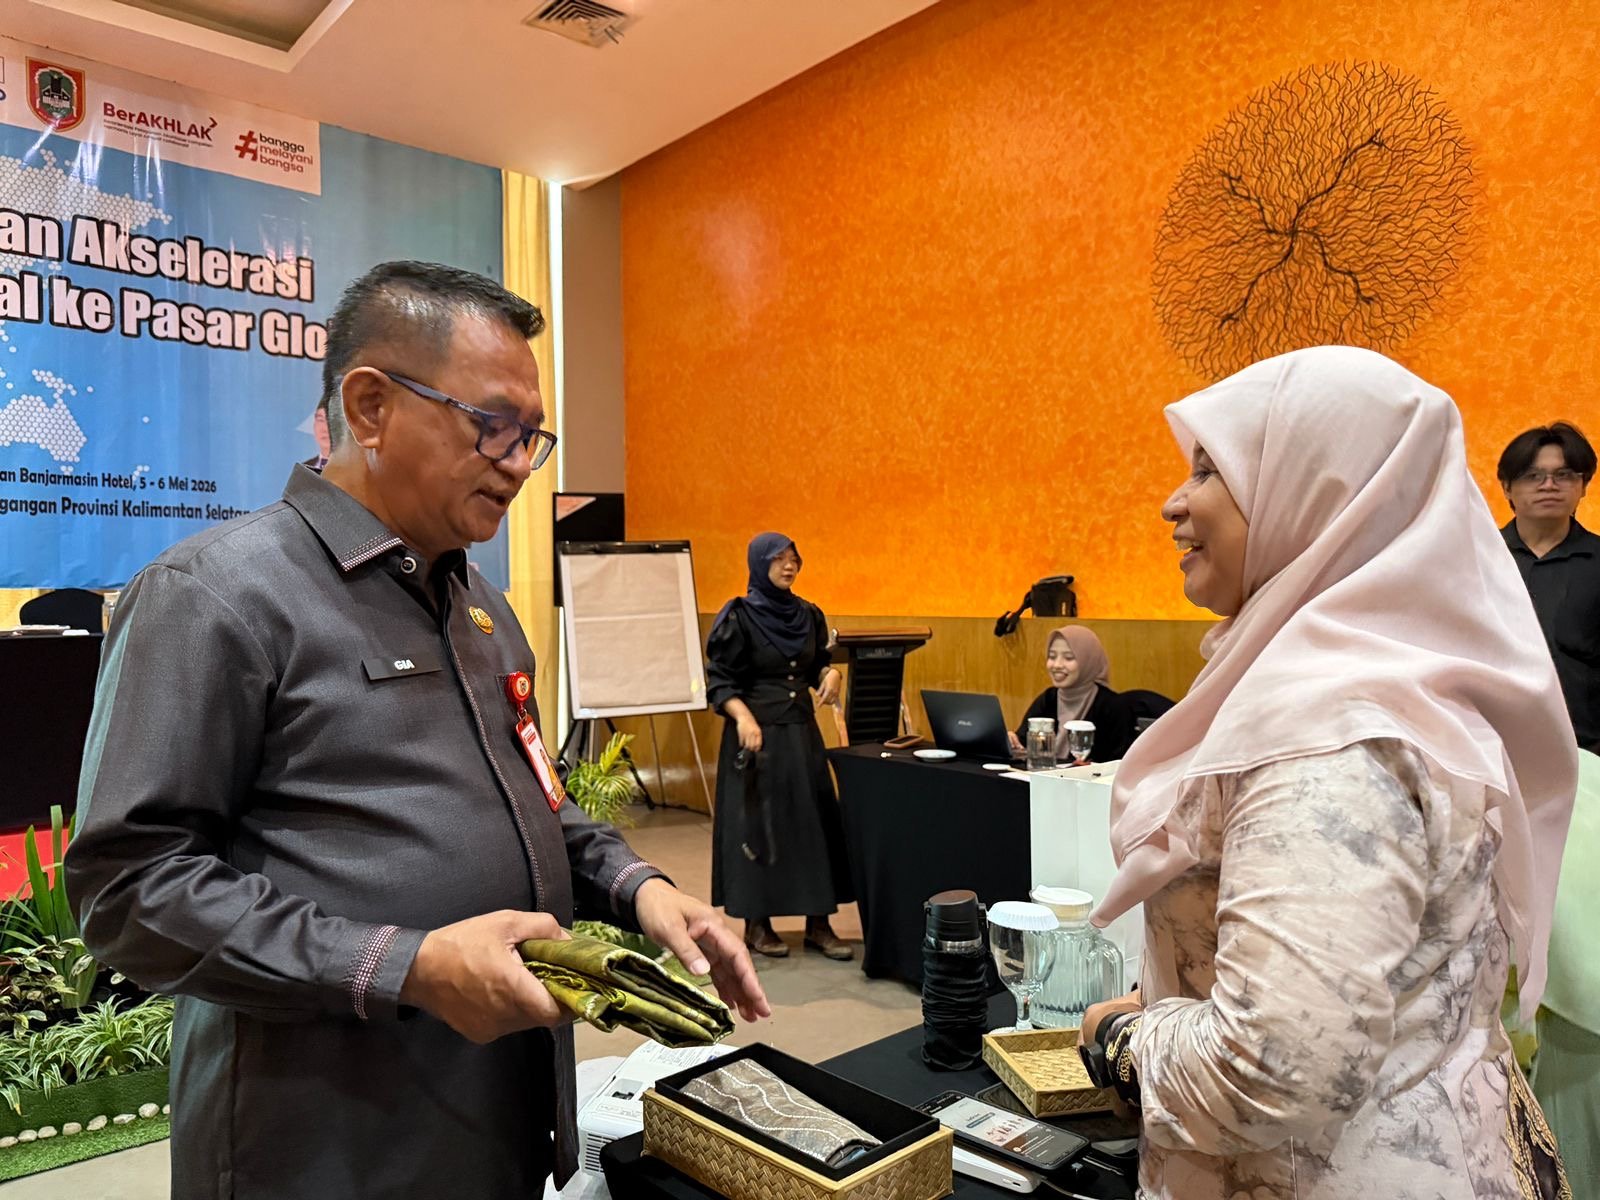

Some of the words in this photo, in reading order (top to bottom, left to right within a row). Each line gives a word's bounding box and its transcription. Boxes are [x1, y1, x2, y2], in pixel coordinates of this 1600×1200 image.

[103, 102, 213, 142] BerAKHLAK
[259, 132, 305, 153] bangga
[260, 145, 314, 165] melayani
[260, 154, 304, 173] bangsa
[67, 214, 314, 302] Akselerasi
[49, 275, 114, 333] ke
[120, 287, 255, 350] Pasar
[260, 308, 330, 361] Glo
[20, 467, 98, 487] Banjarmasin
[102, 472, 137, 491] Hotel,
[140, 477, 146, 489] 5
[158, 477, 165, 490] 6
[169, 475, 188, 491] Mei
[191, 479, 217, 493] 2026
[61, 496, 118, 516] Provinsi
[122, 499, 202, 519] Kalimantan
[206, 503, 250, 521] Selata
[394, 659, 415, 670] GIA
